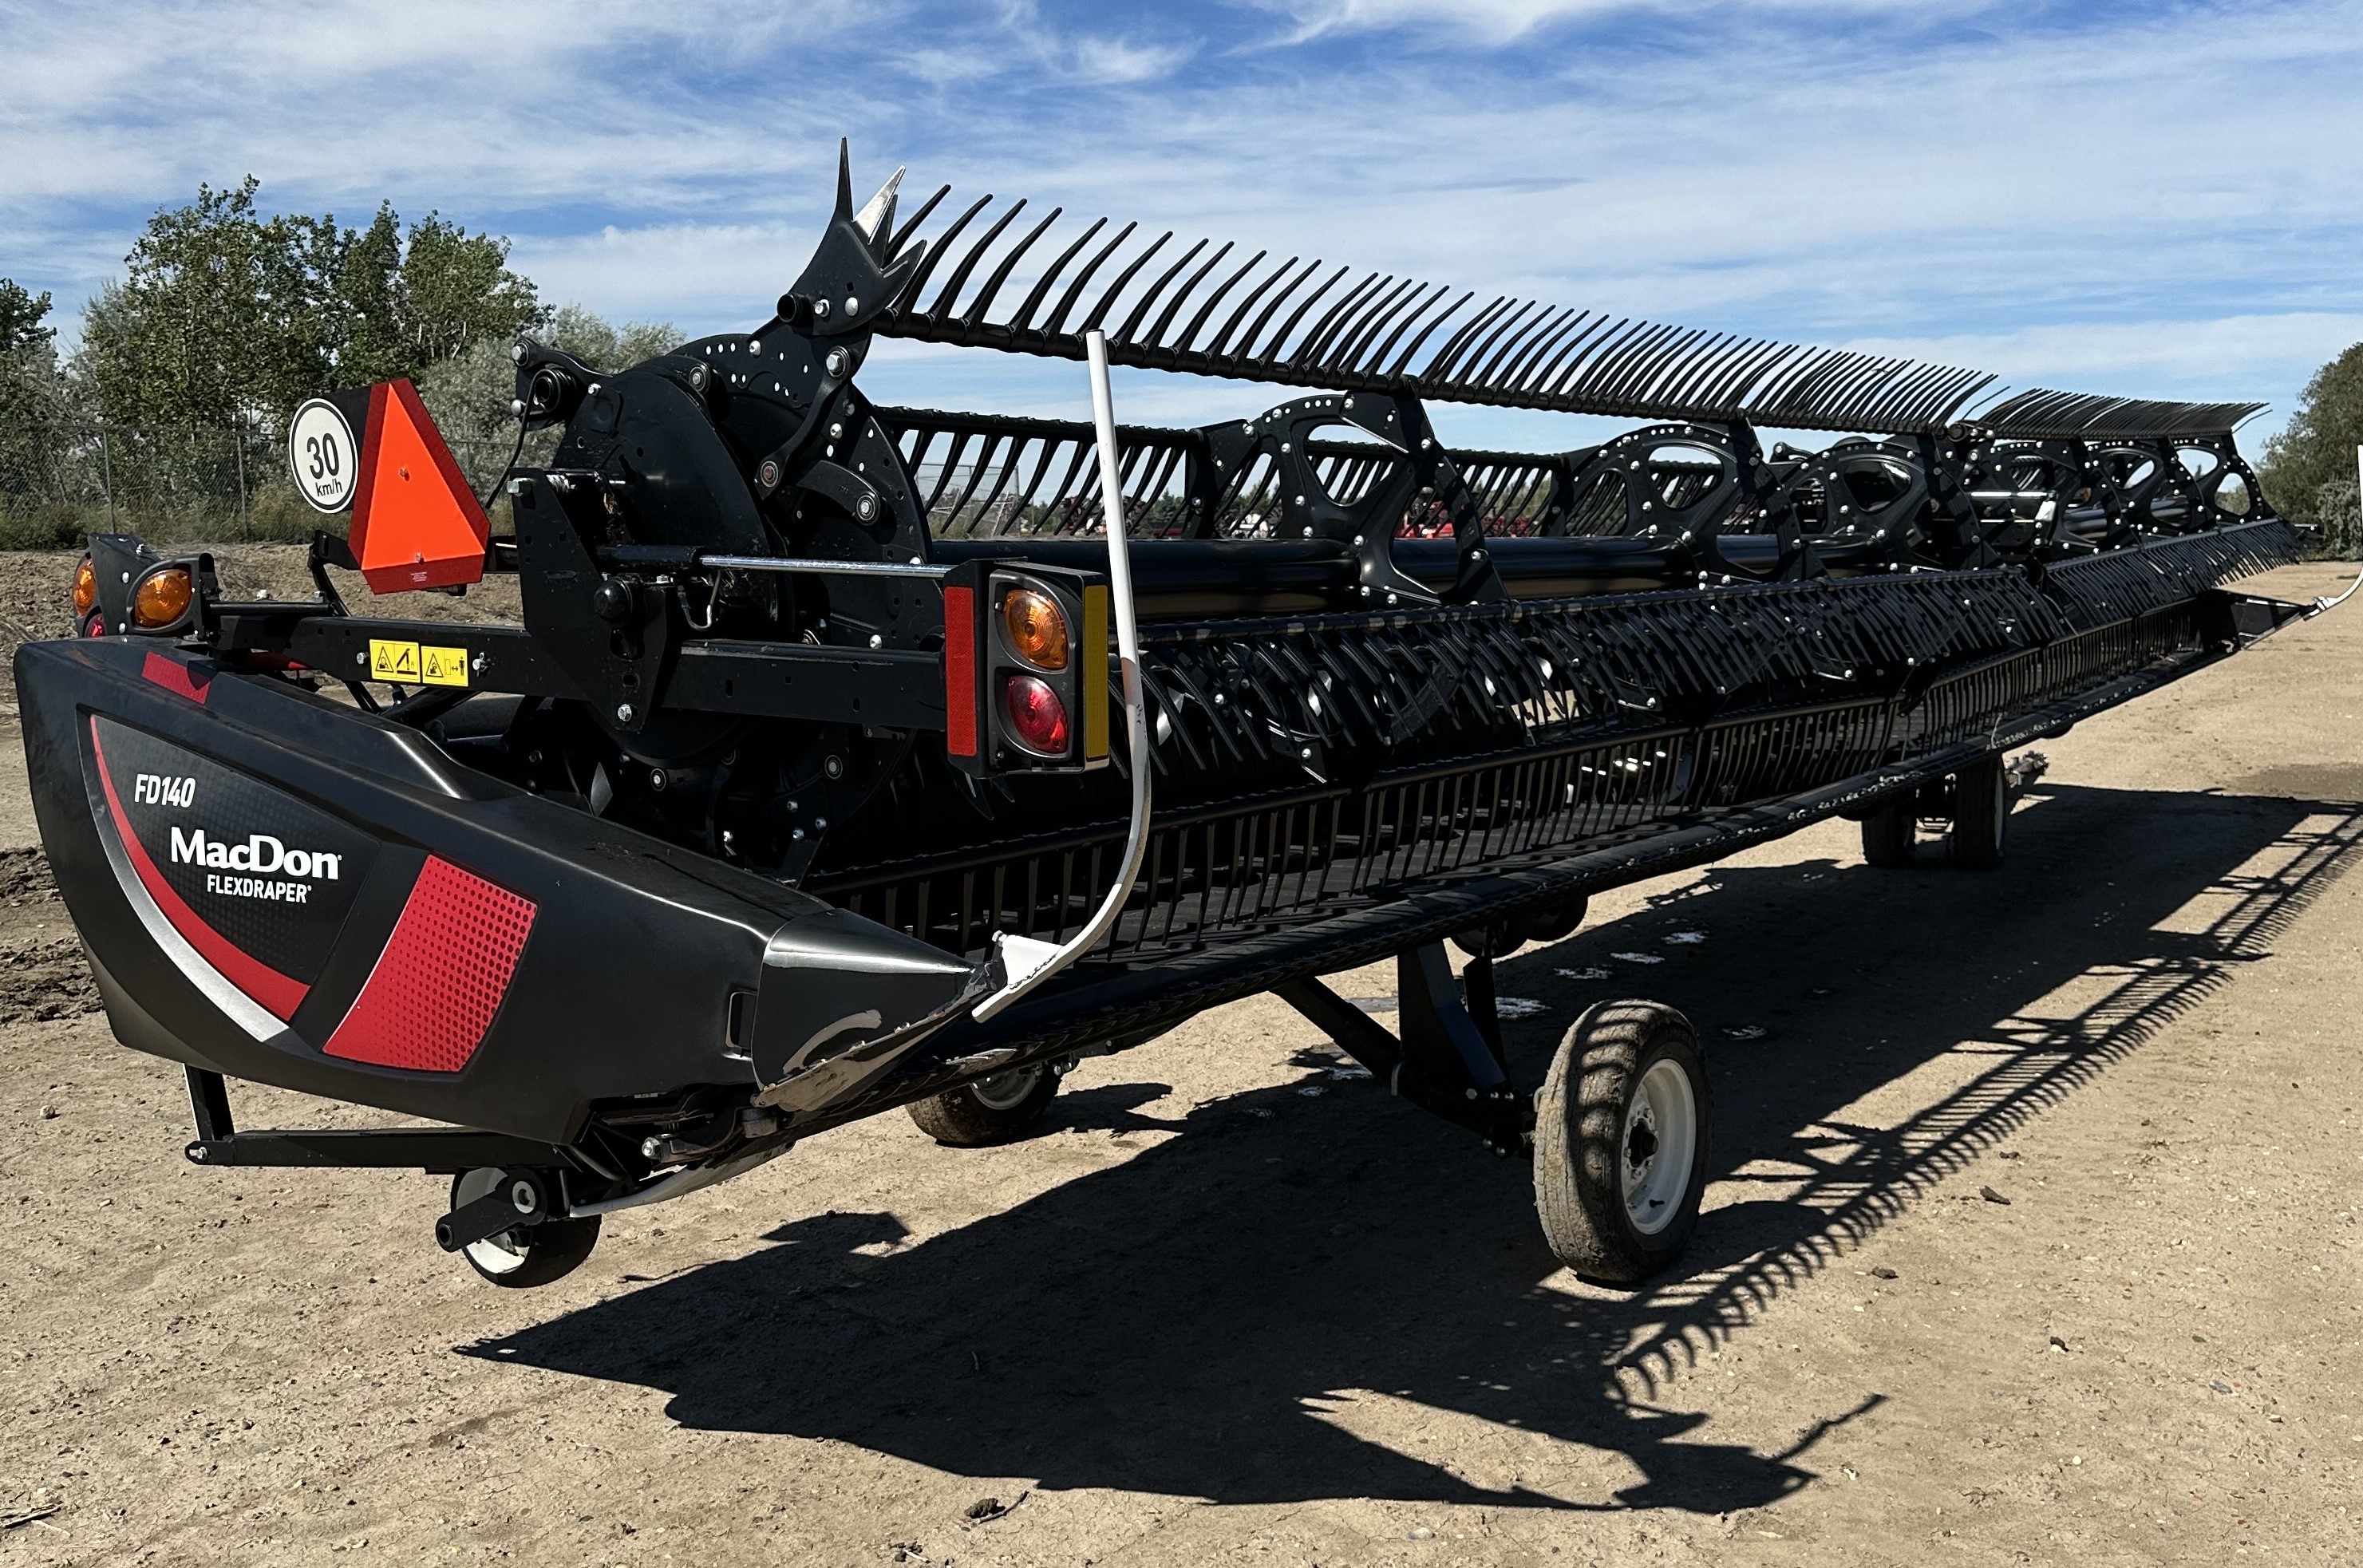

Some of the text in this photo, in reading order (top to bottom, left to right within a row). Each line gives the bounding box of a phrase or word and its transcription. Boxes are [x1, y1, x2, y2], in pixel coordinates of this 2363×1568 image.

[306, 432, 340, 480] 30
[315, 478, 343, 497] km/h
[134, 773, 196, 808] FD140
